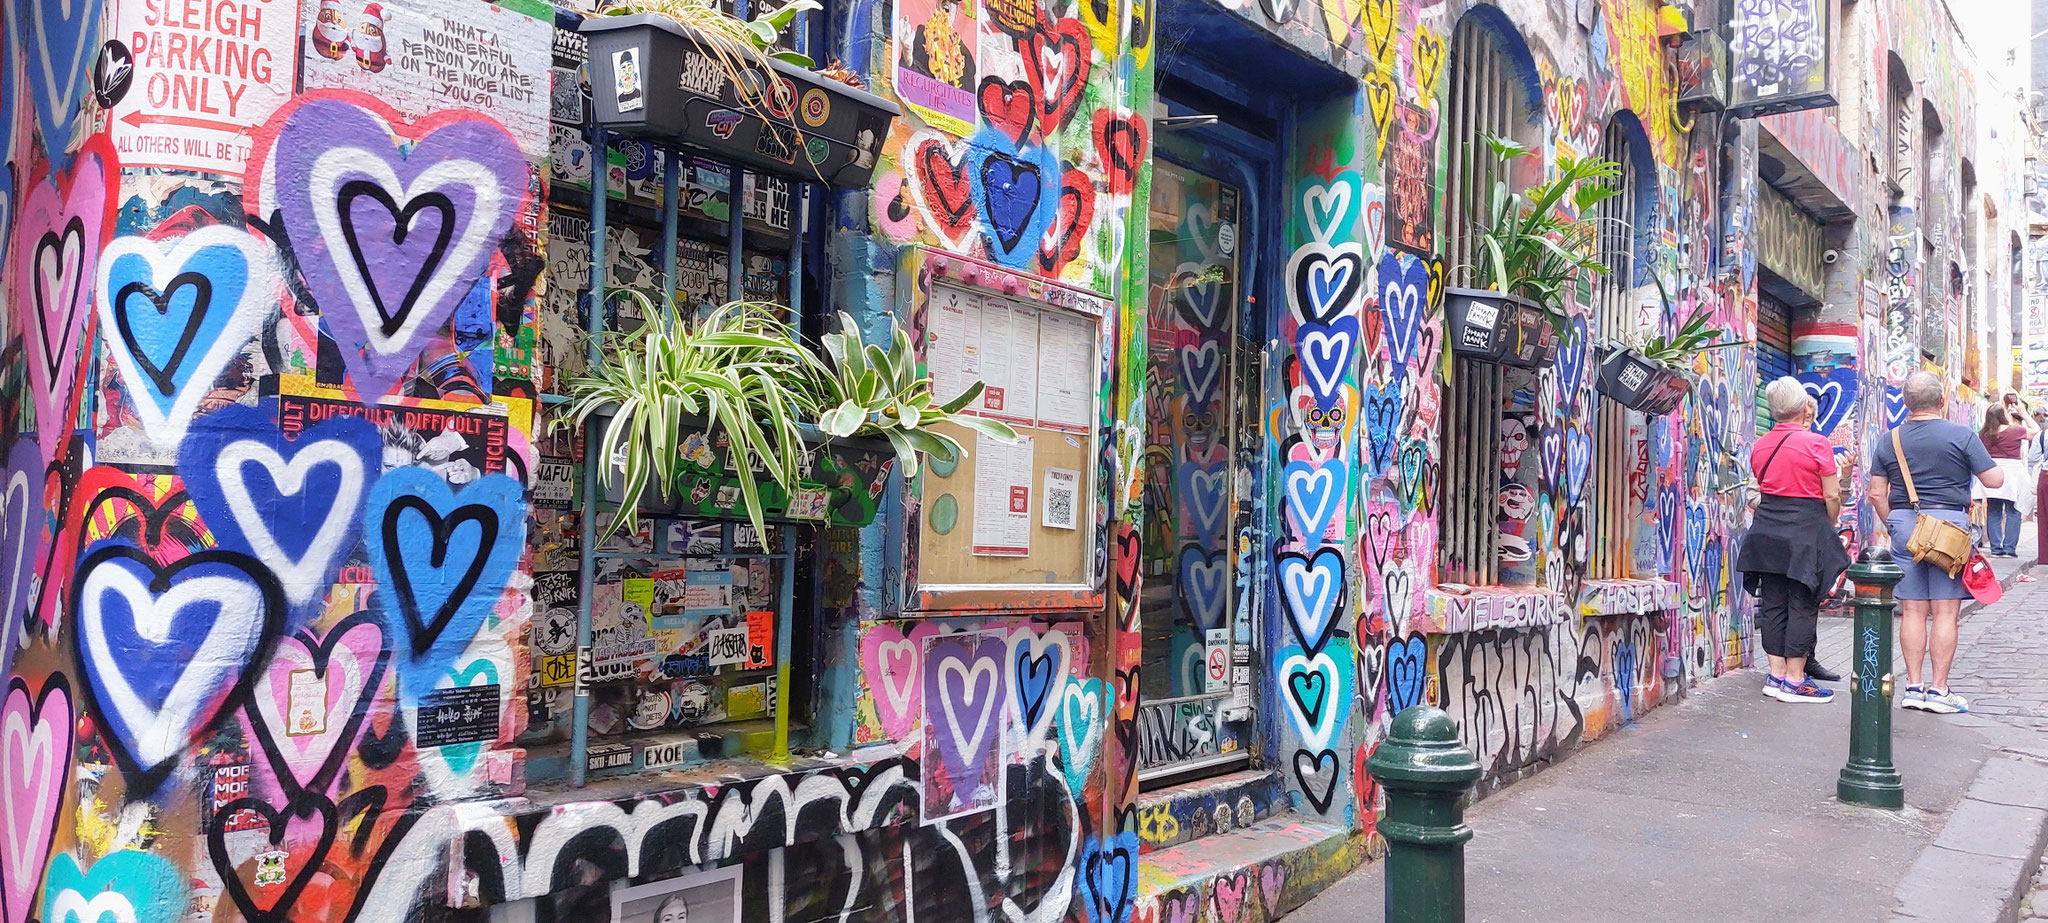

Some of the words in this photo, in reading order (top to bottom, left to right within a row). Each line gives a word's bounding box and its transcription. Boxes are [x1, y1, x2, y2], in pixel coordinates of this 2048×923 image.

[145, 0, 261, 41] SLEIGH
[443, 18, 487, 42] WHAT
[490, 33, 499, 48] A
[132, 32, 272, 84] PARKING
[402, 38, 463, 69] PERSON
[468, 57, 497, 78] YOU
[423, 28, 517, 68] WONDERFUL
[401, 55, 420, 73] ON
[425, 61, 458, 82] THE
[148, 72, 247, 117] ONLY
[441, 82, 470, 102] YOU
[118, 136, 133, 152] ALL
[137, 136, 179, 155] OTHERS
[184, 139, 211, 158] WILL
[217, 142, 231, 161] BE
[1469, 309, 1494, 328] FRANK
[1472, 302, 1496, 318] ETHAN
[1462, 334, 1488, 348] FRANK
[1465, 326, 1489, 339] ETHAN
[1620, 373, 1640, 391] FRANK
[1624, 362, 1647, 384] ETHAN
[405, 412, 483, 435] DIFFICULT
[1606, 583, 1667, 615] HOSIER
[1453, 592, 1565, 632] MELBOURNE
[589, 752, 632, 769] SKU-ALONE
[645, 746, 682, 766] EXOE
